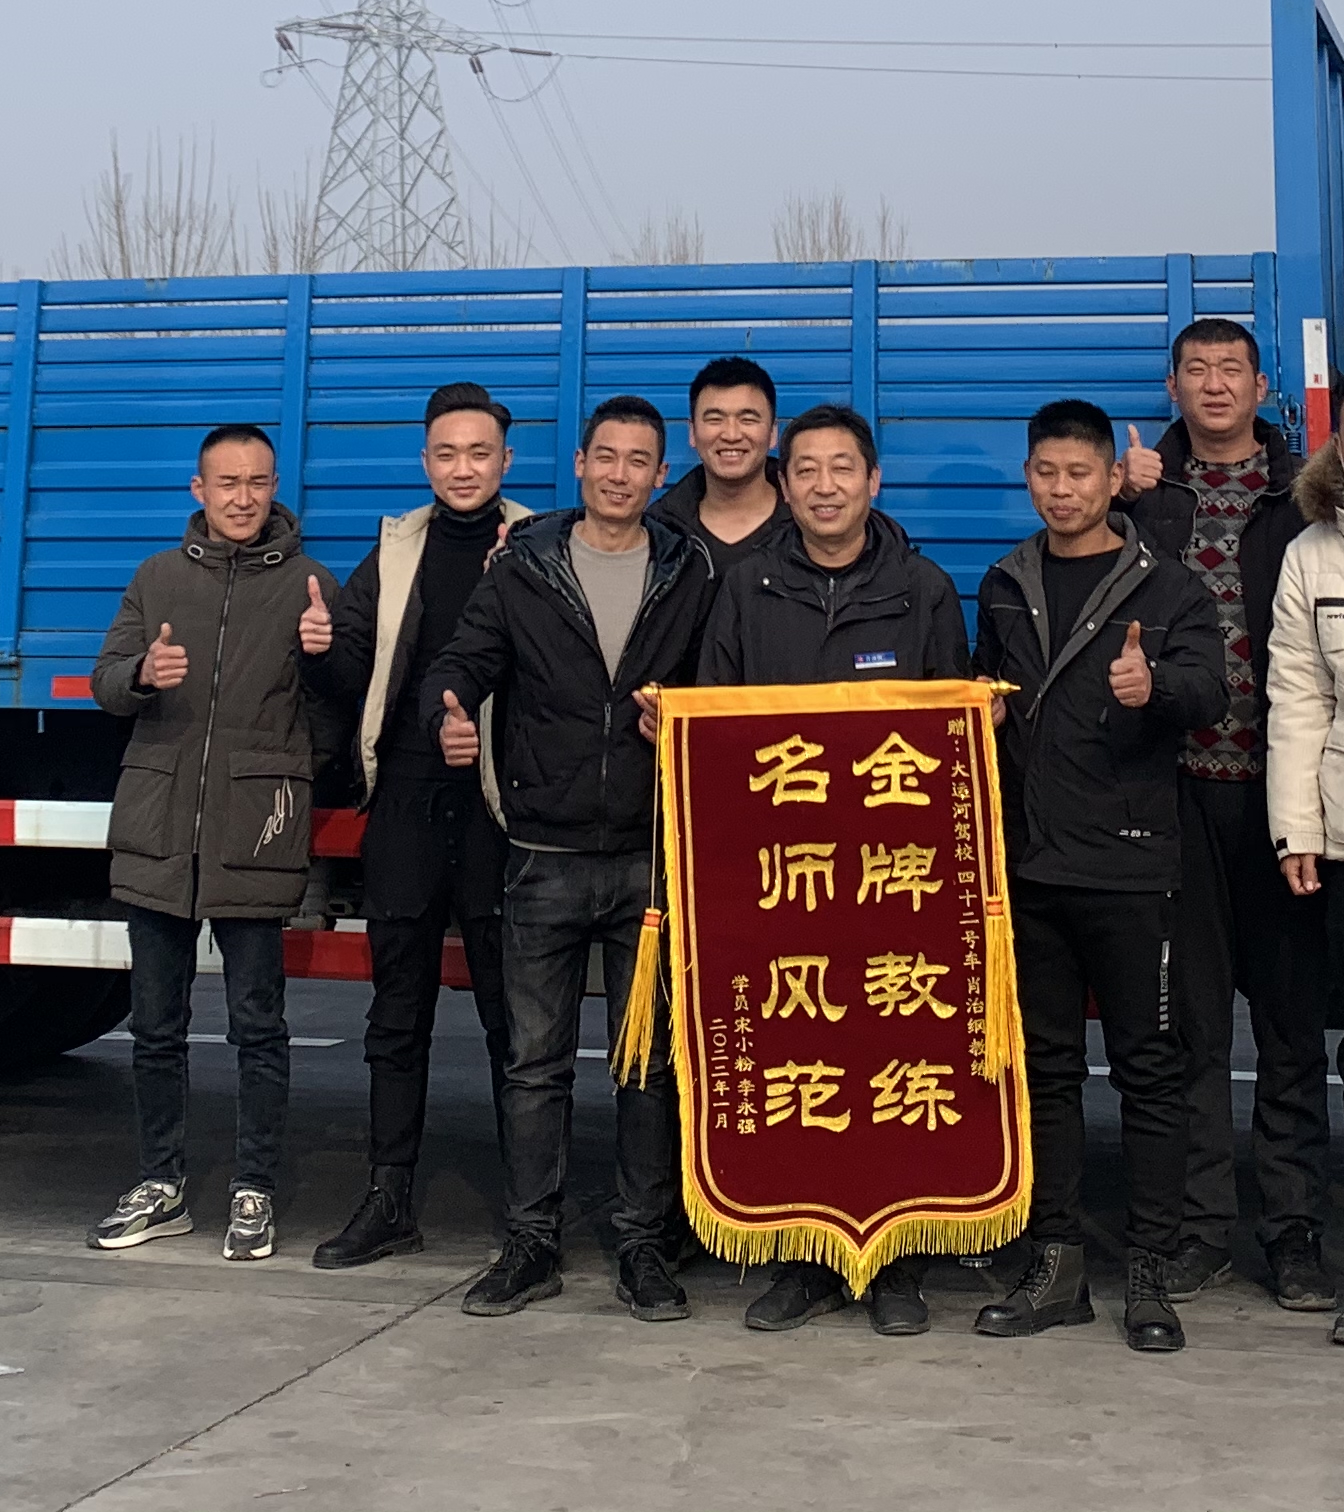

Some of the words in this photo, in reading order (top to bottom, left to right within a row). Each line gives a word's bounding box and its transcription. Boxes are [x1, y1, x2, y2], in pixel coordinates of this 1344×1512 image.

[749, 733, 852, 1134] 名师风范
[852, 731, 963, 1131] 金牌教练
